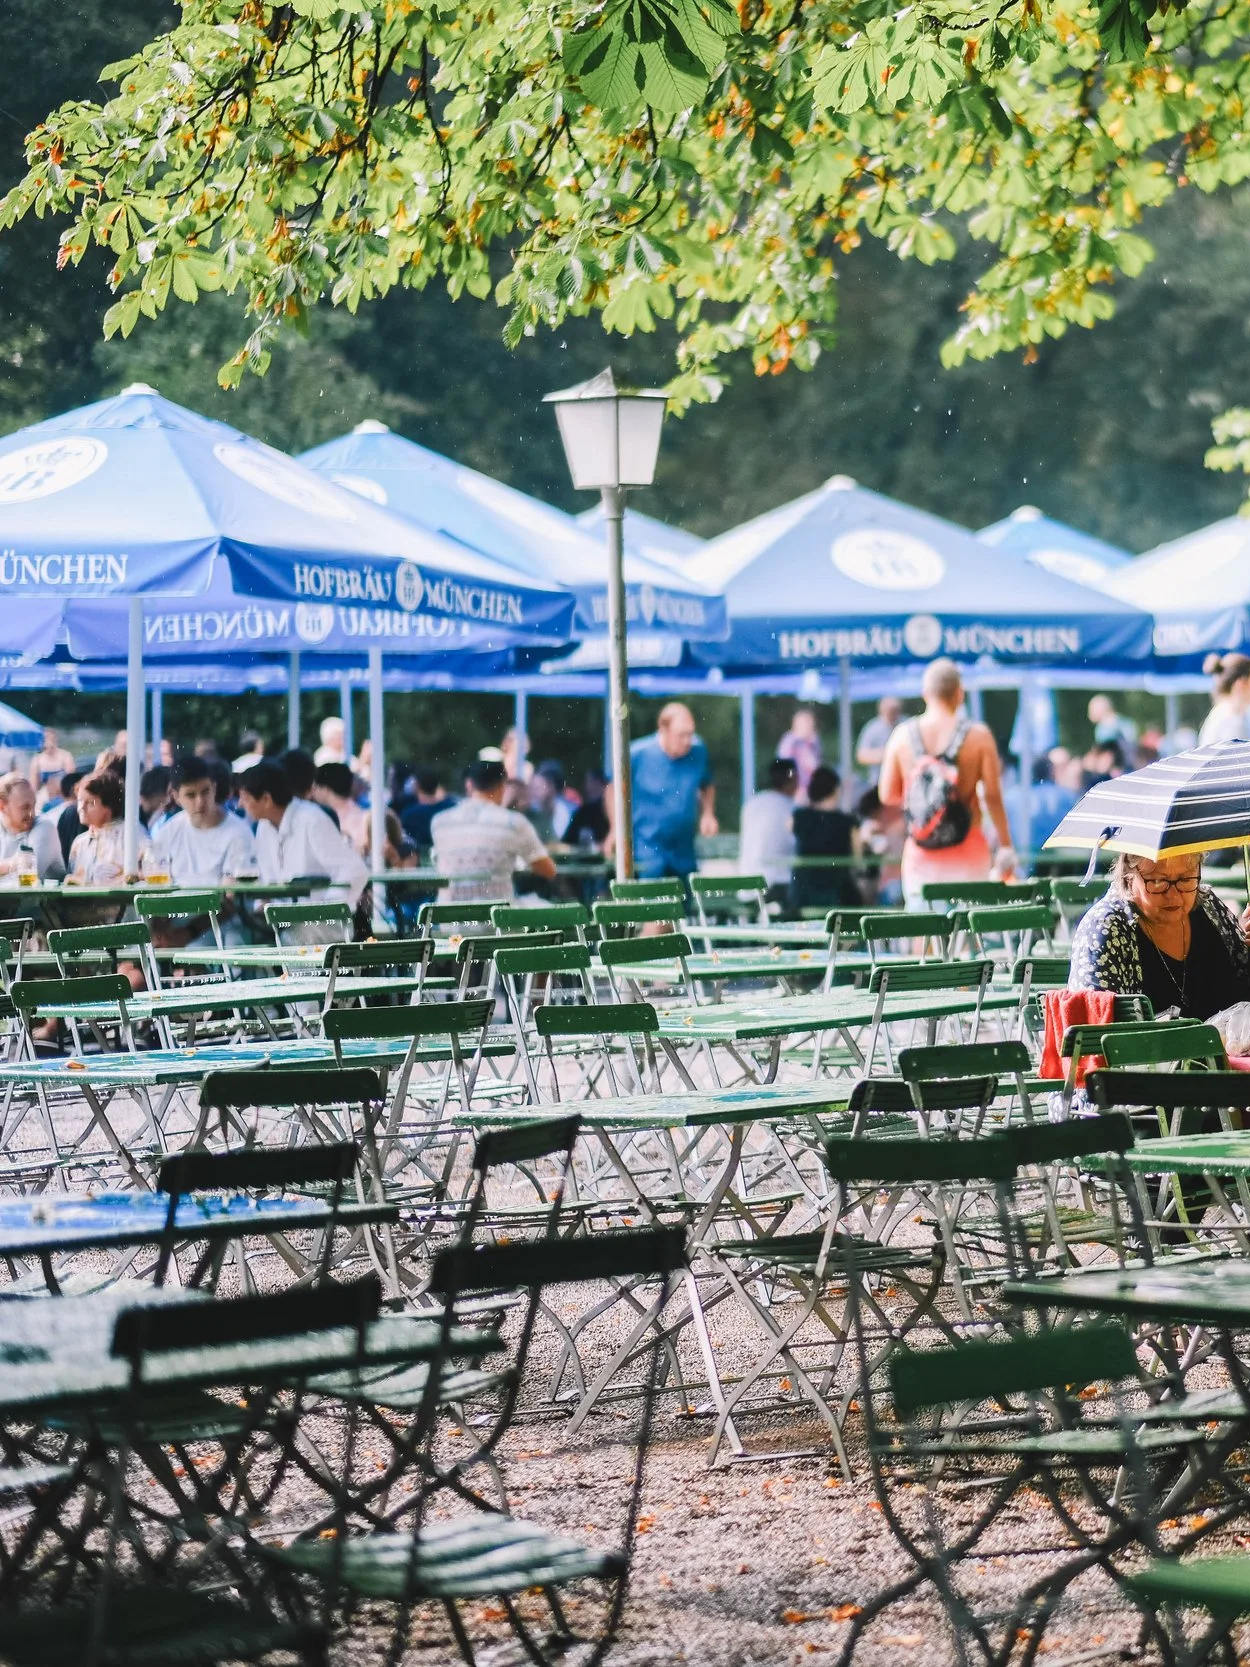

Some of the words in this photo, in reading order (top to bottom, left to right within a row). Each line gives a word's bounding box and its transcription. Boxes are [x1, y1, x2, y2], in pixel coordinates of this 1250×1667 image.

[293, 563, 393, 602] HOFBRÄU
[425, 576, 523, 624] MÜNCHEN
[778, 624, 900, 658] HOFBRÄU
[944, 623, 1080, 652] MÜNCHEN
